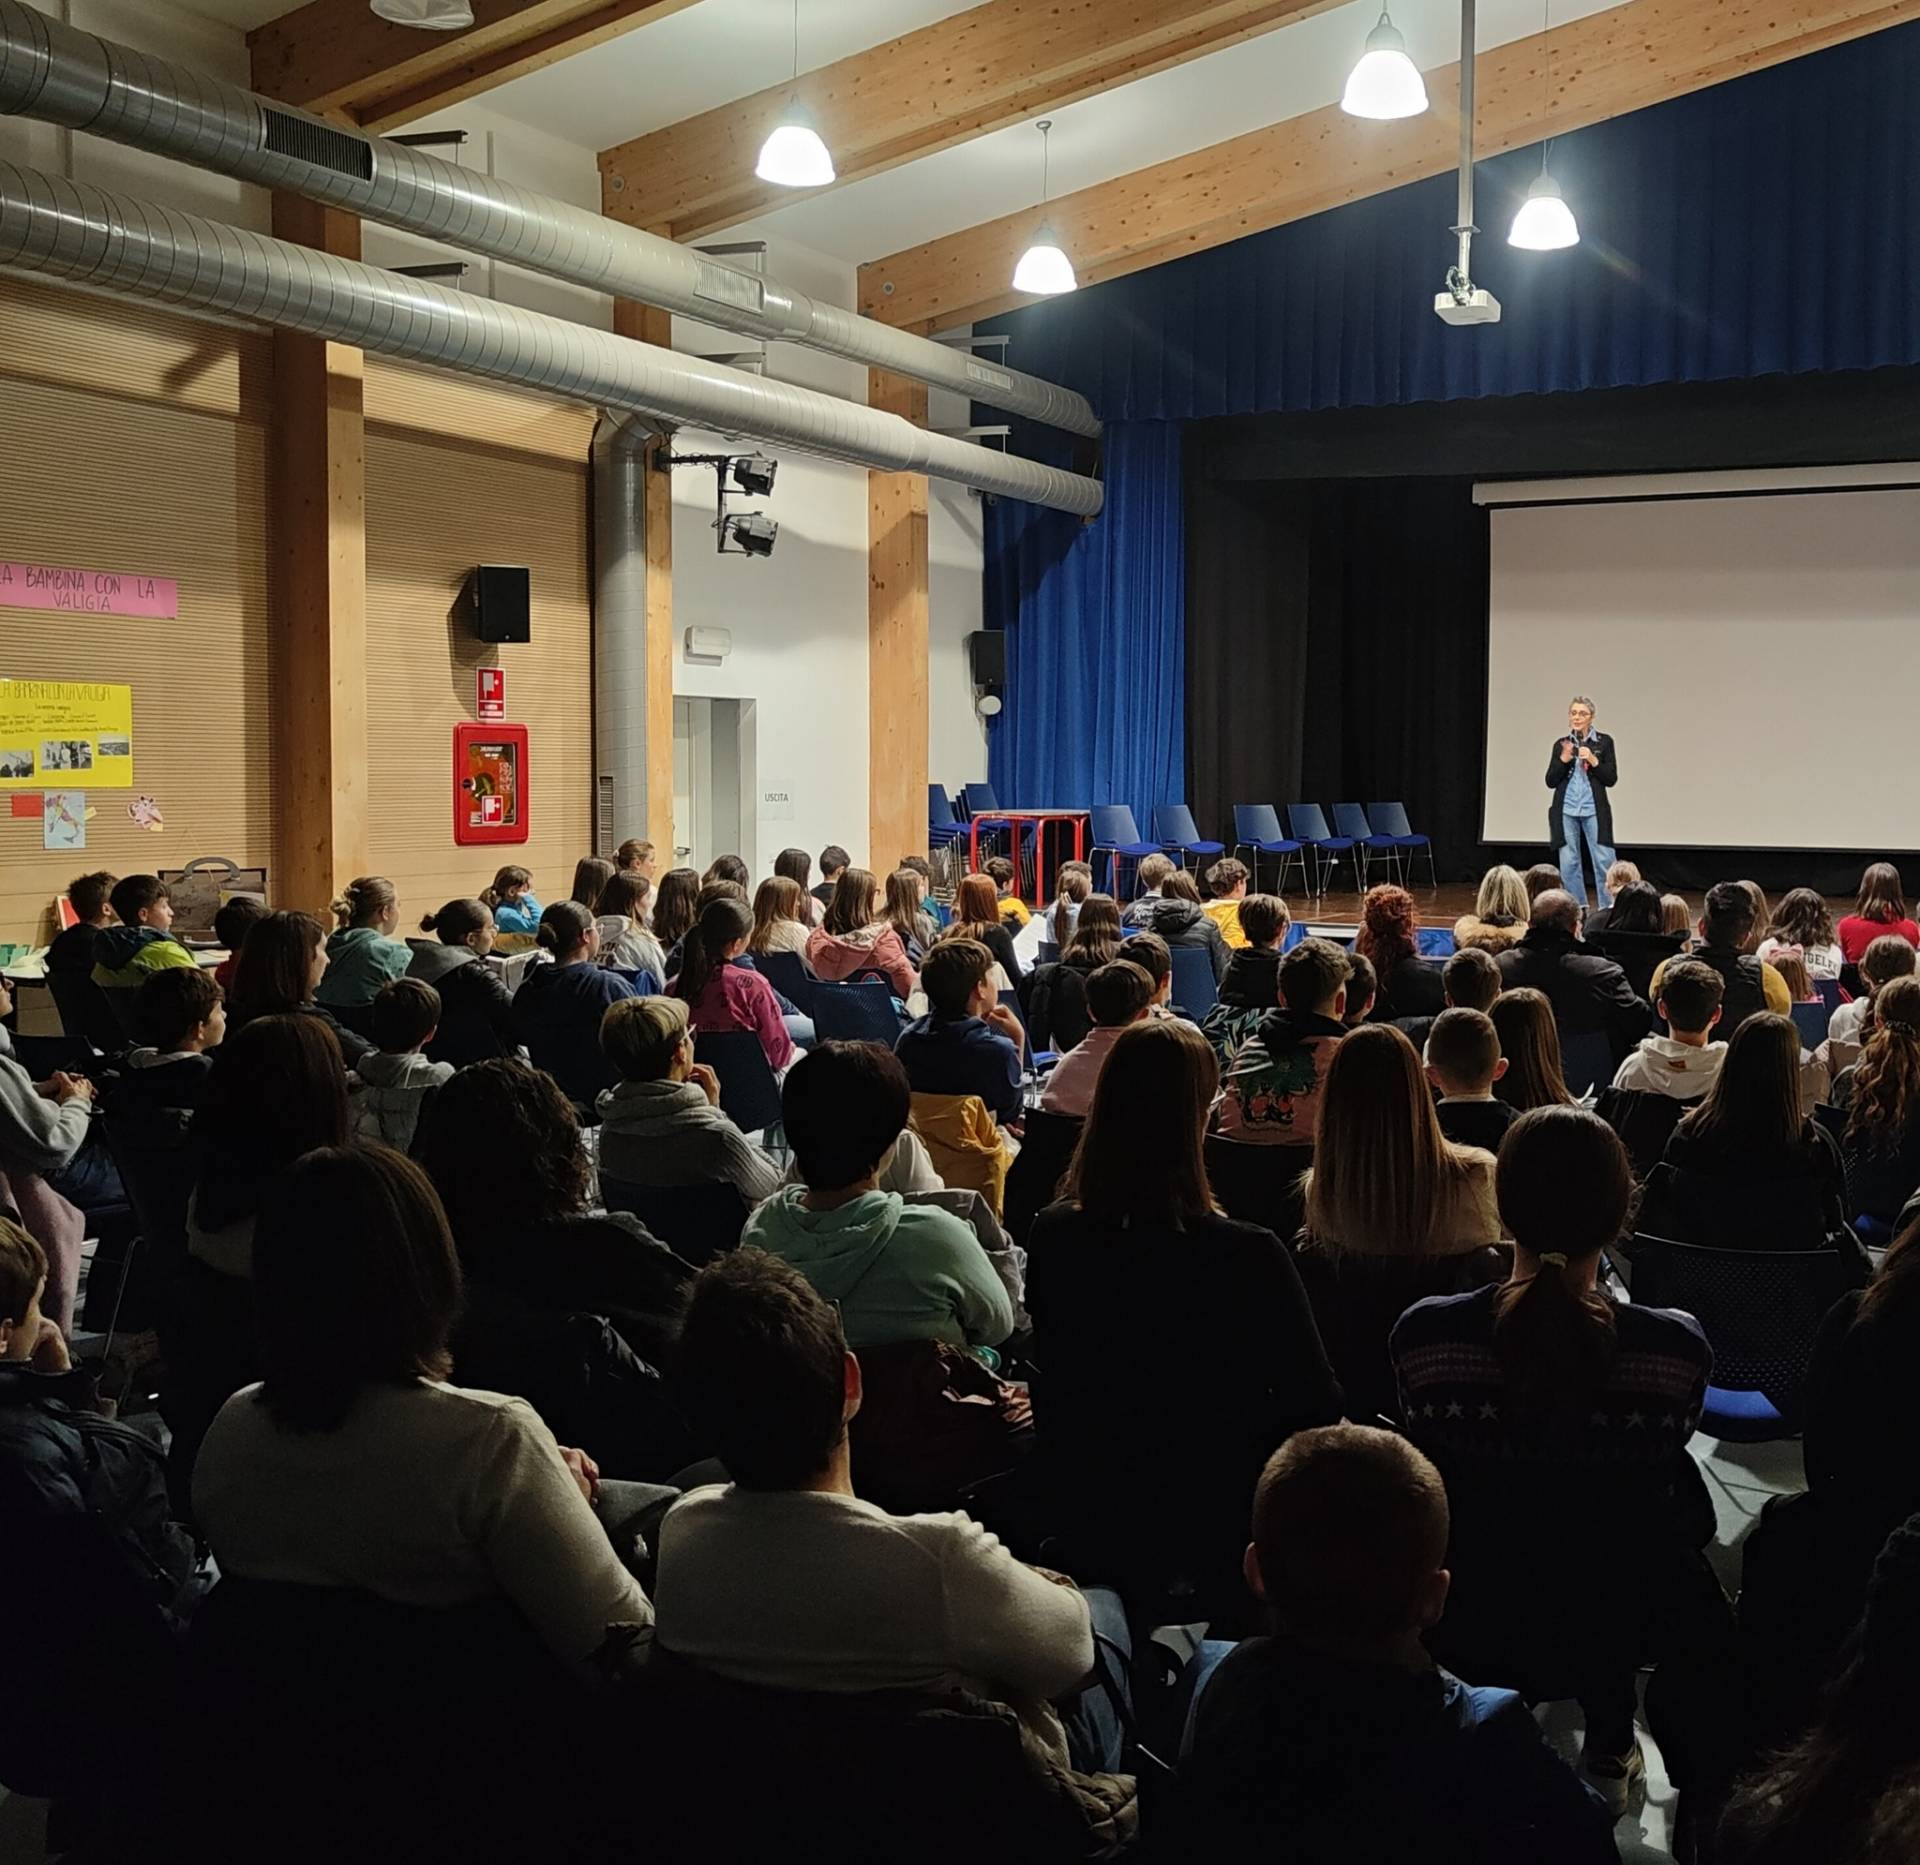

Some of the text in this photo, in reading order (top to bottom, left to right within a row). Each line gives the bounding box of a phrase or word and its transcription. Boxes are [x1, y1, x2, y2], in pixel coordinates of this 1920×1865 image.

[0, 564, 155, 600] A BAMBINA CON LA
[53, 591, 111, 611] VALIGIA
[764, 793, 789, 802] USCITA
